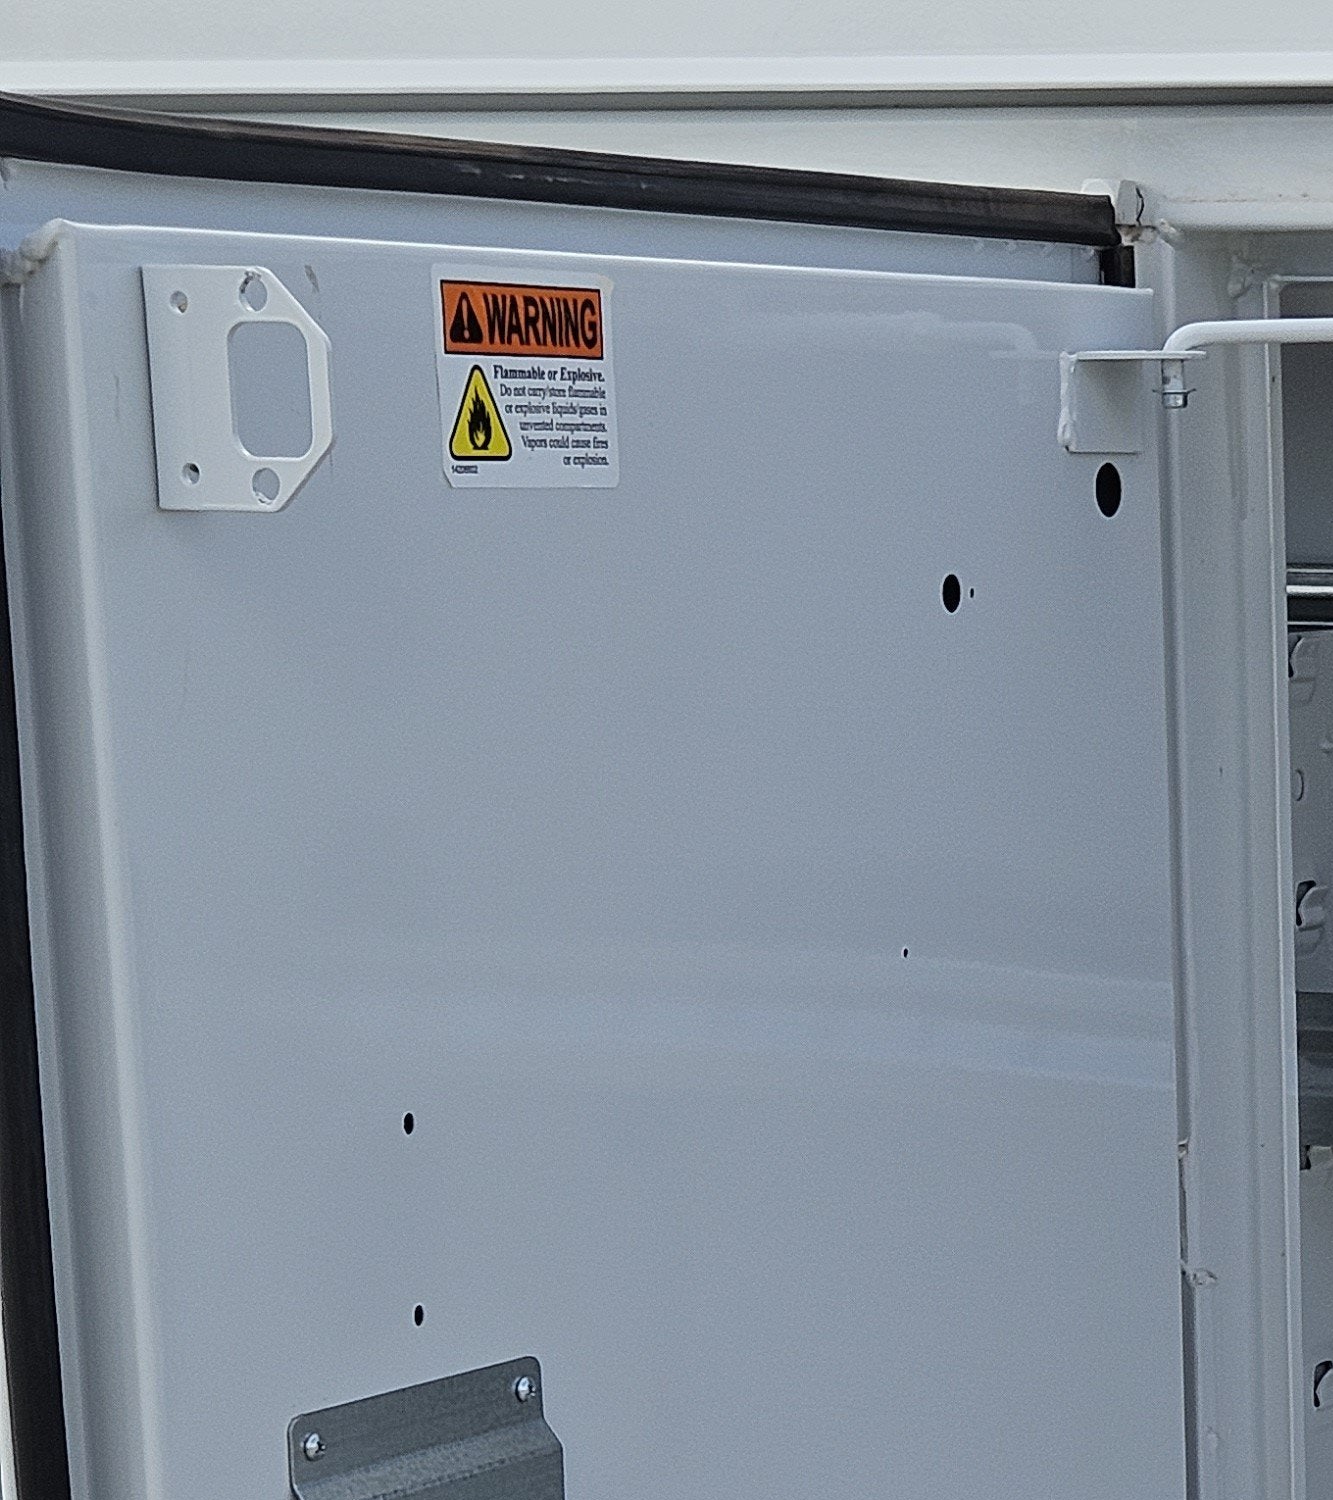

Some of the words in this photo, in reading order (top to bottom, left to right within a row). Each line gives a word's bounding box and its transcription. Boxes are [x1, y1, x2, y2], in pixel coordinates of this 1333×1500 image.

[482, 292, 598, 350] WARNING
[493, 365, 545, 380] Flammable
[547, 369, 558, 381] or
[560, 366, 606, 385] Explosive.
[500, 384, 512, 397] Do
[513, 385, 527, 397] not
[568, 385, 606, 399] flammable
[504, 404, 513, 414] or
[515, 402, 550, 418] explosive
[519, 418, 554, 431] unvented
[521, 435, 547, 451] Vapors
[549, 435, 570, 449] could
[571, 439, 591, 449] cause
[563, 456, 572, 466] or
